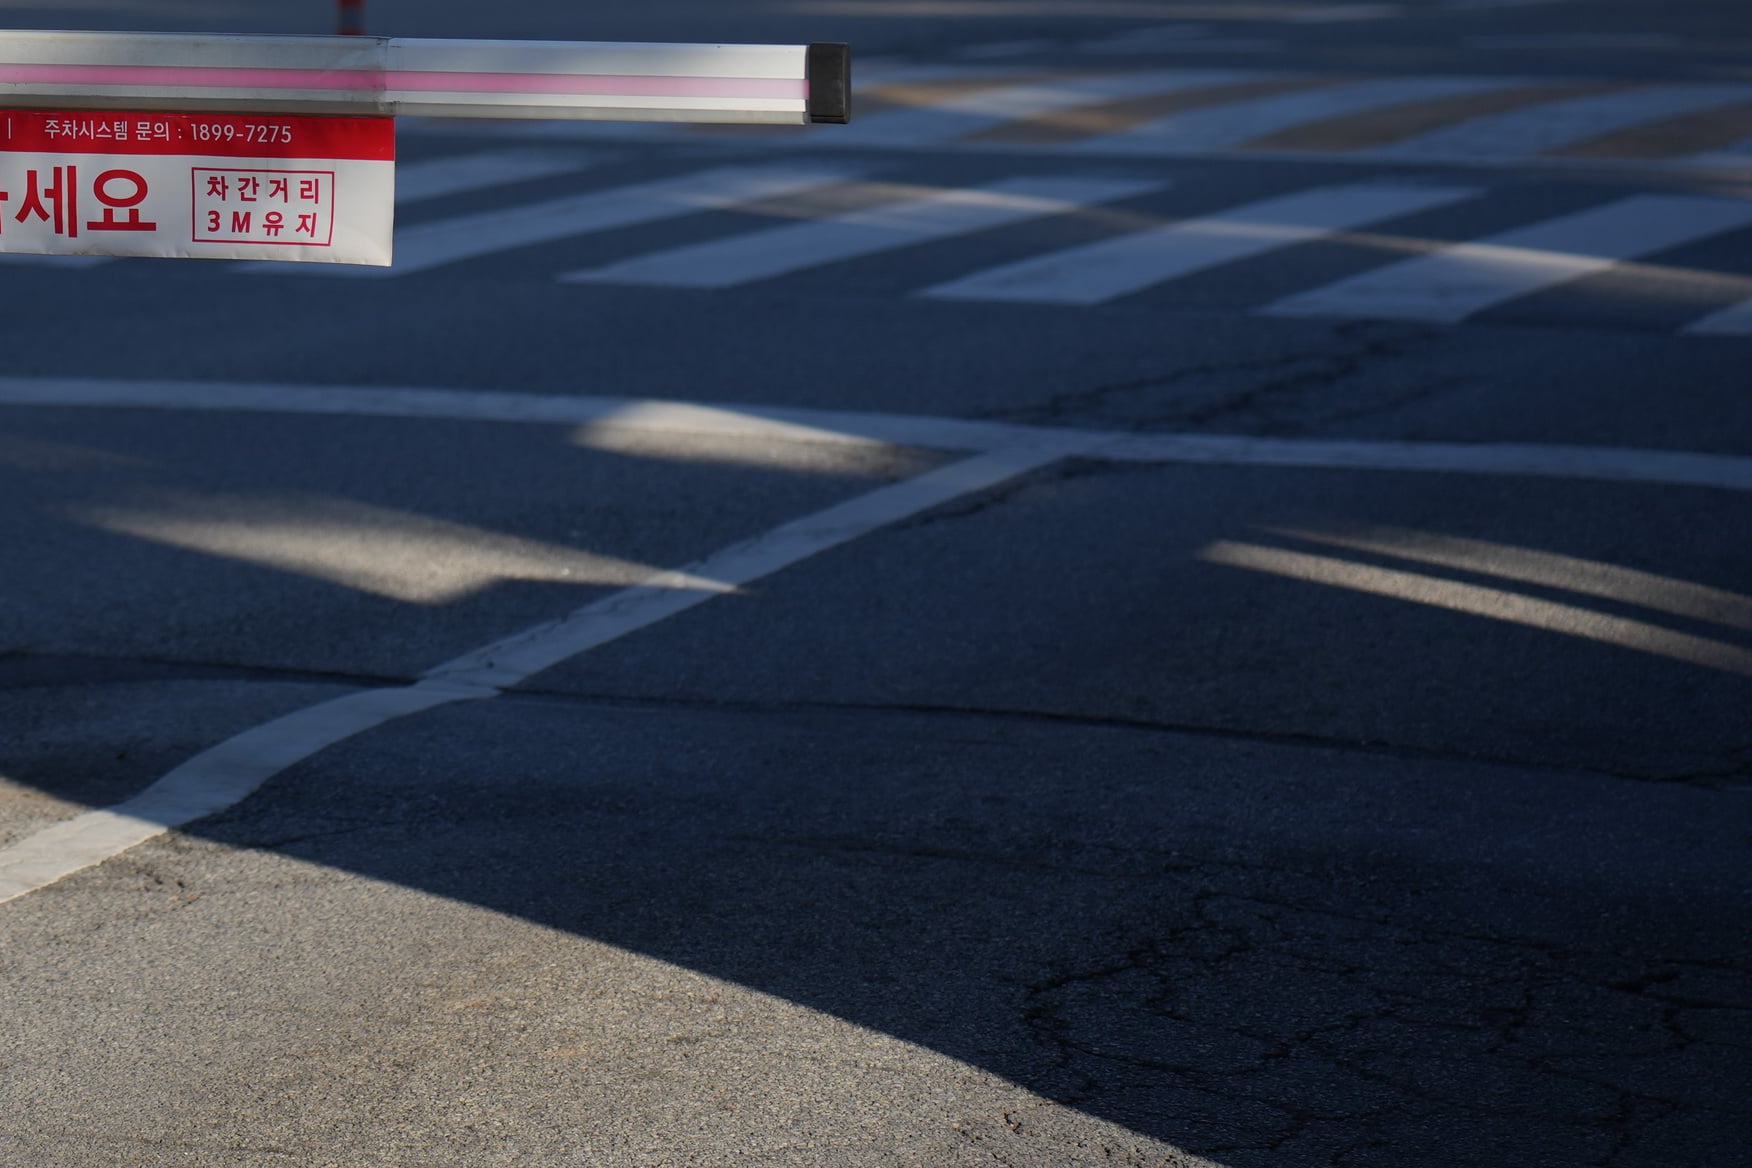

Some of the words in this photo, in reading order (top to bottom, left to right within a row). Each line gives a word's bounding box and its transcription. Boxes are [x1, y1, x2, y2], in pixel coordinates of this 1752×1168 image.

[44, 119, 129, 141] 주차시스템
[135, 120, 171, 142] 문의
[190, 122, 293, 144] 1899-7275
[206, 176, 320, 205] 차간거리
